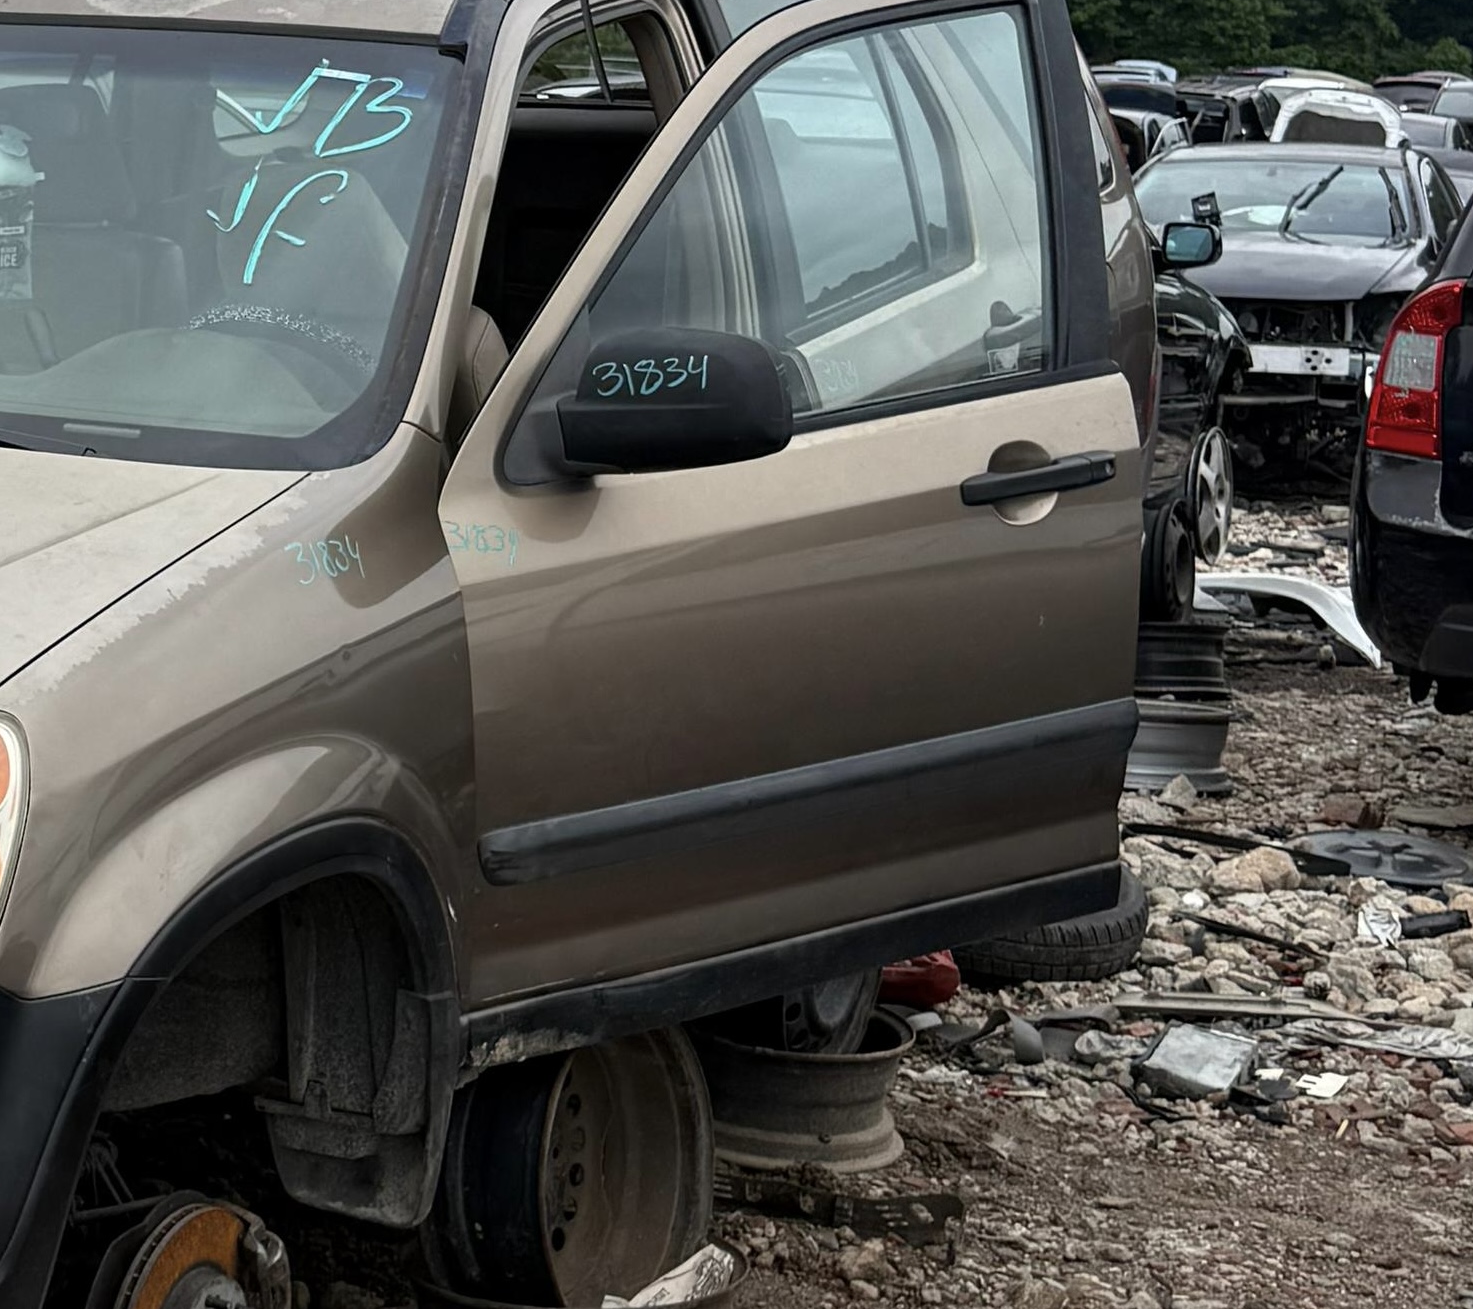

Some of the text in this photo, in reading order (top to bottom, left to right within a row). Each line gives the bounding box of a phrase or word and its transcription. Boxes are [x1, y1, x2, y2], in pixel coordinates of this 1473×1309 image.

[0, 253, 18, 267] ICE
[592, 354, 709, 397] 31834
[284, 534, 366, 585] 31834
